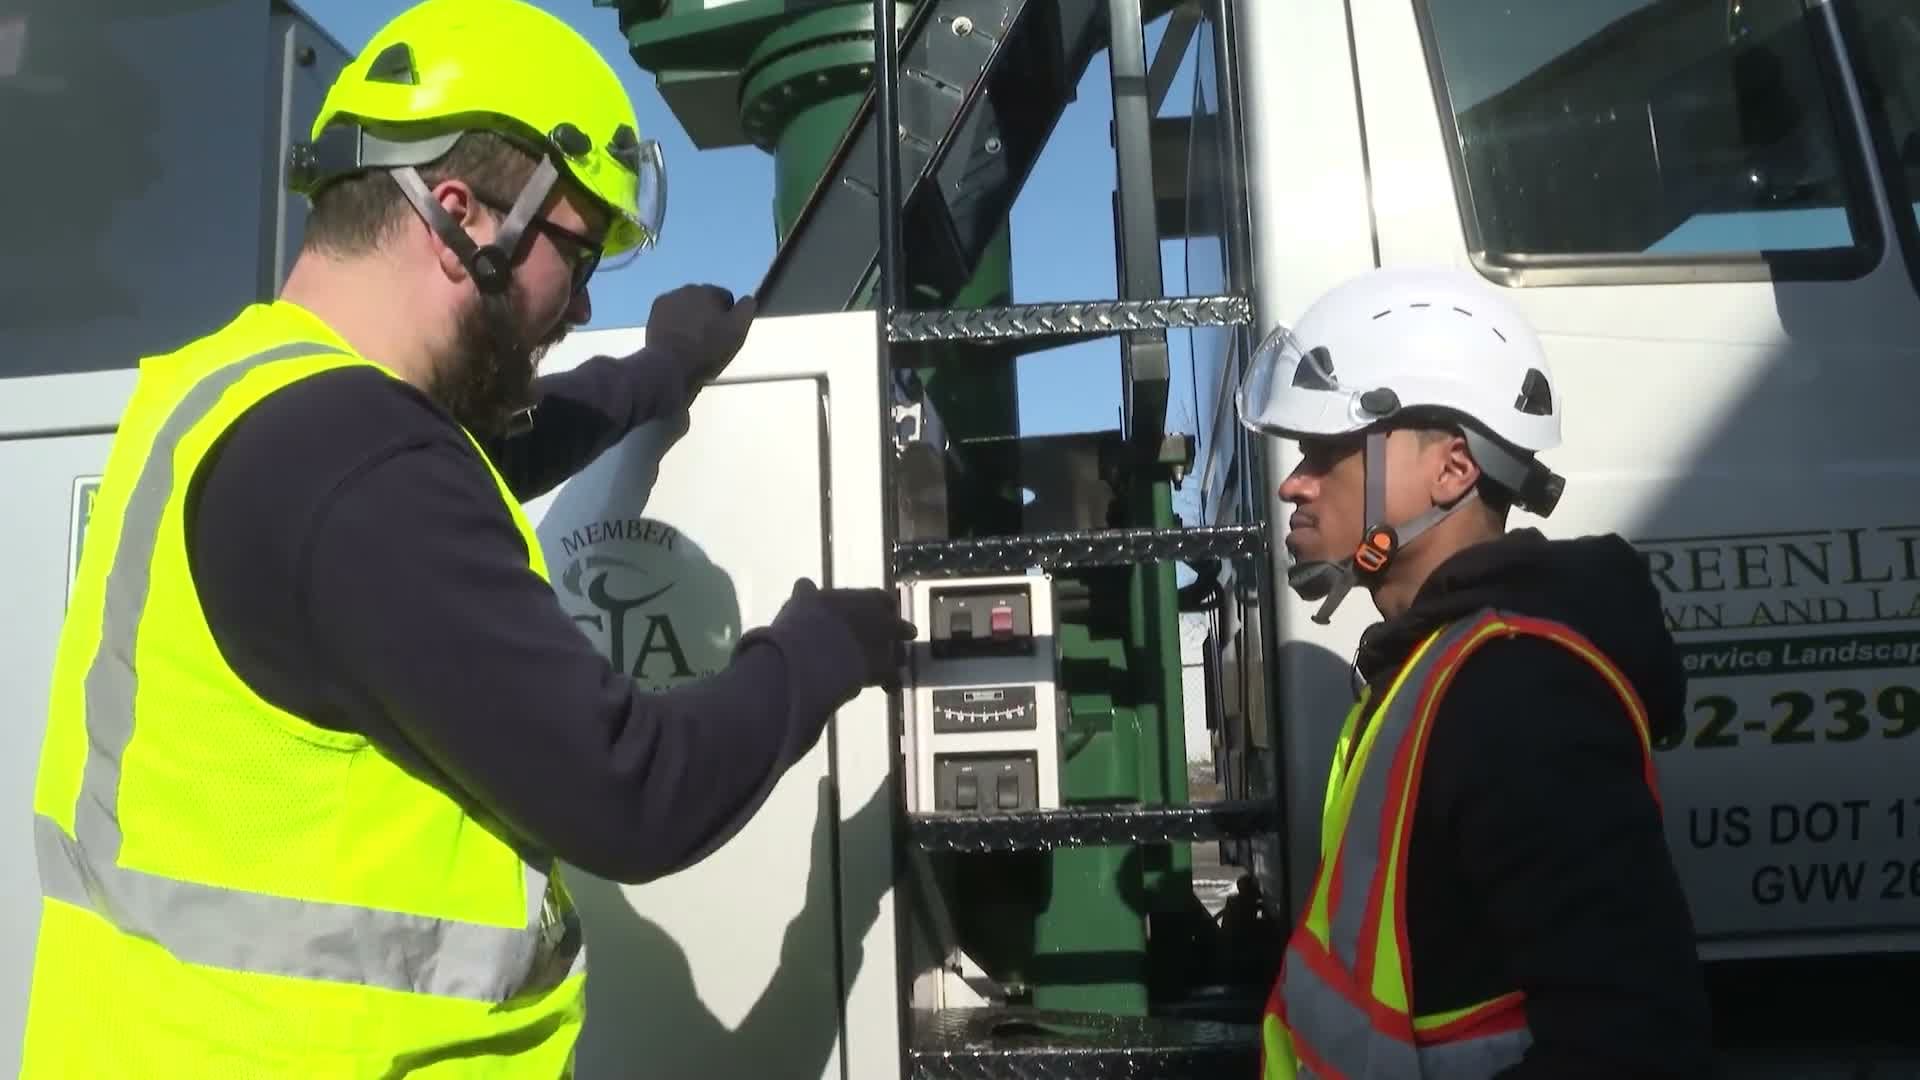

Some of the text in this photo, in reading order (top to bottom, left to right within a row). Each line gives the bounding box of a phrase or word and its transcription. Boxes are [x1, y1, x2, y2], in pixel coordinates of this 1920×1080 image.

[561, 519, 677, 556] MEMBER
[1751, 597, 1848, 624] AND
[1682, 646, 1770, 671] ervice
[1690, 805, 1750, 848] US
[1771, 800, 1870, 845] DOT
[1752, 861, 1867, 905] GVW
